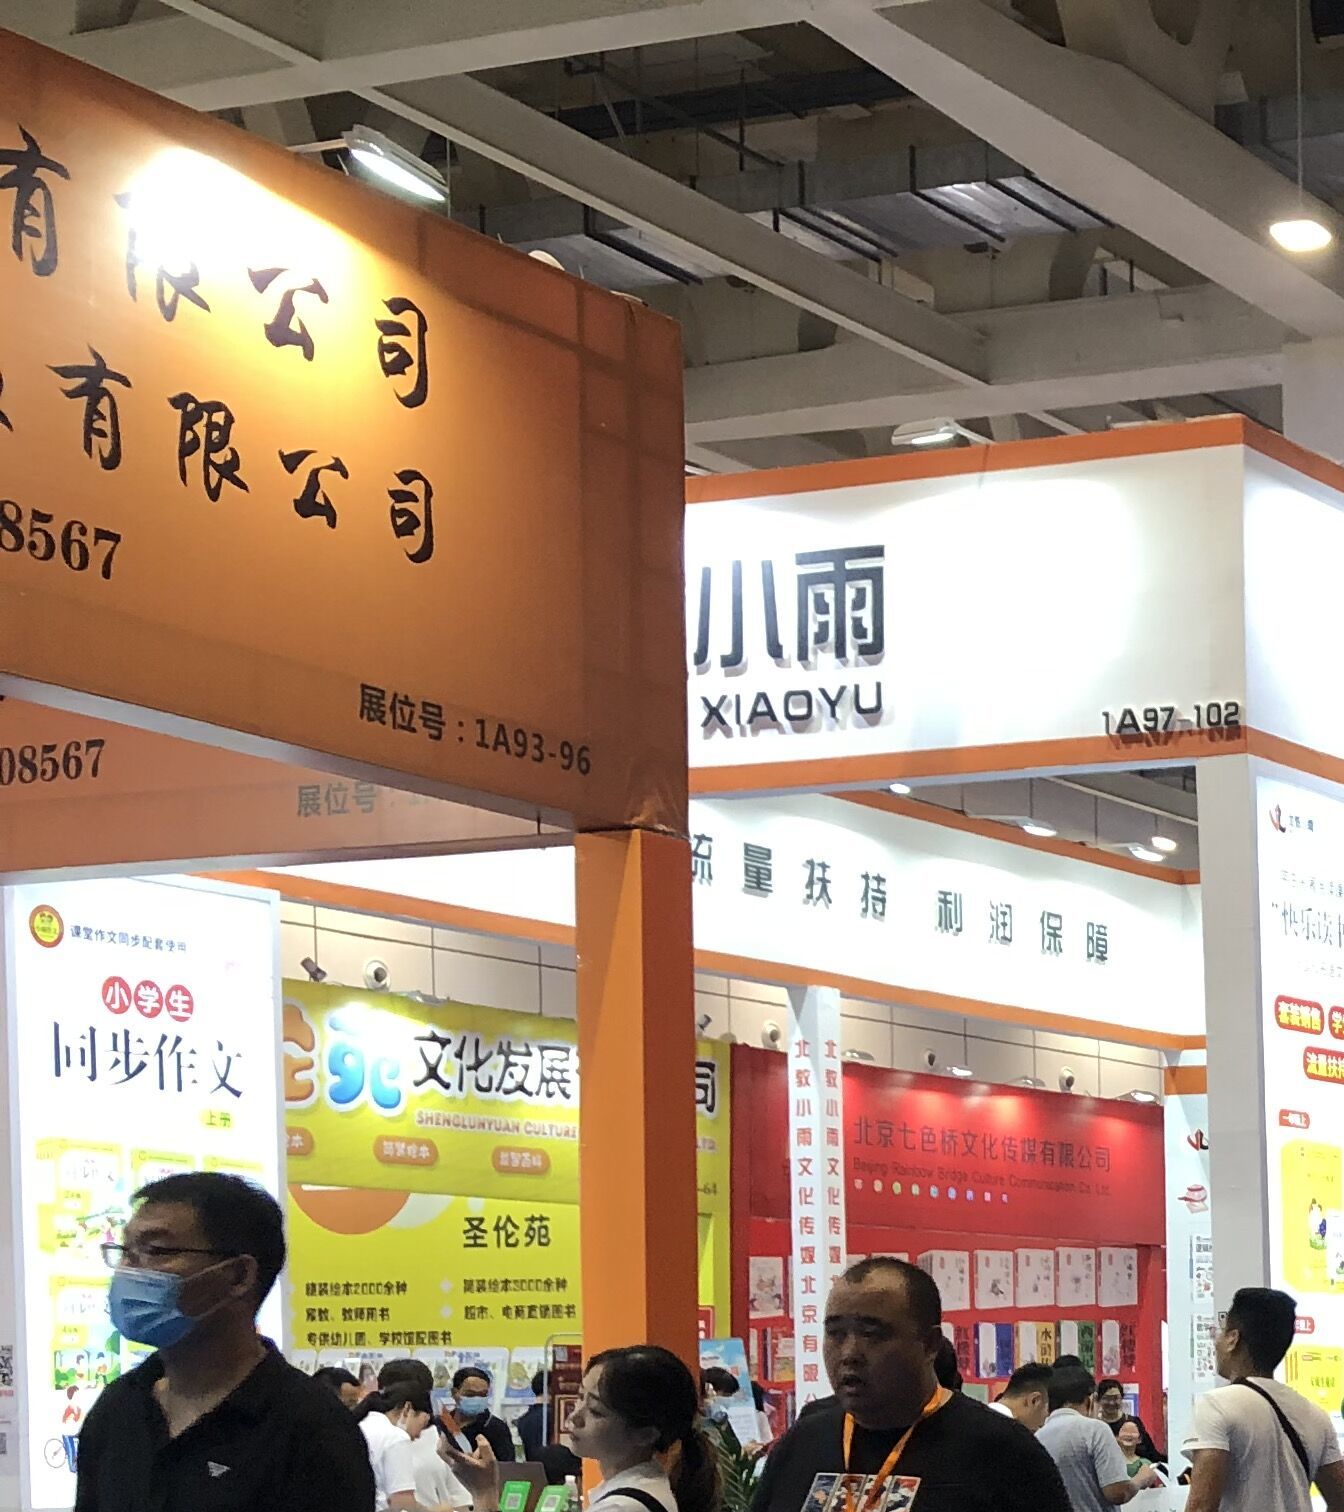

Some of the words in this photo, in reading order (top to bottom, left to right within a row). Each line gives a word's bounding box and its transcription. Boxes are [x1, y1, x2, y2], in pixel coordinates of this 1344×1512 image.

[0, 345, 434, 563] 有限公司
[693, 545, 886, 668] 小雨
[700, 681, 884, 729] XIAOYU
[938, 888, 1110, 966] 利润保障
[104, 980, 193, 1019] 小学生
[53, 1020, 243, 1099] 同步作文
[853, 1115, 1112, 1174] 北京七色桥文化传媒有限公司
[462, 1214, 551, 1249] 圣伦苑
